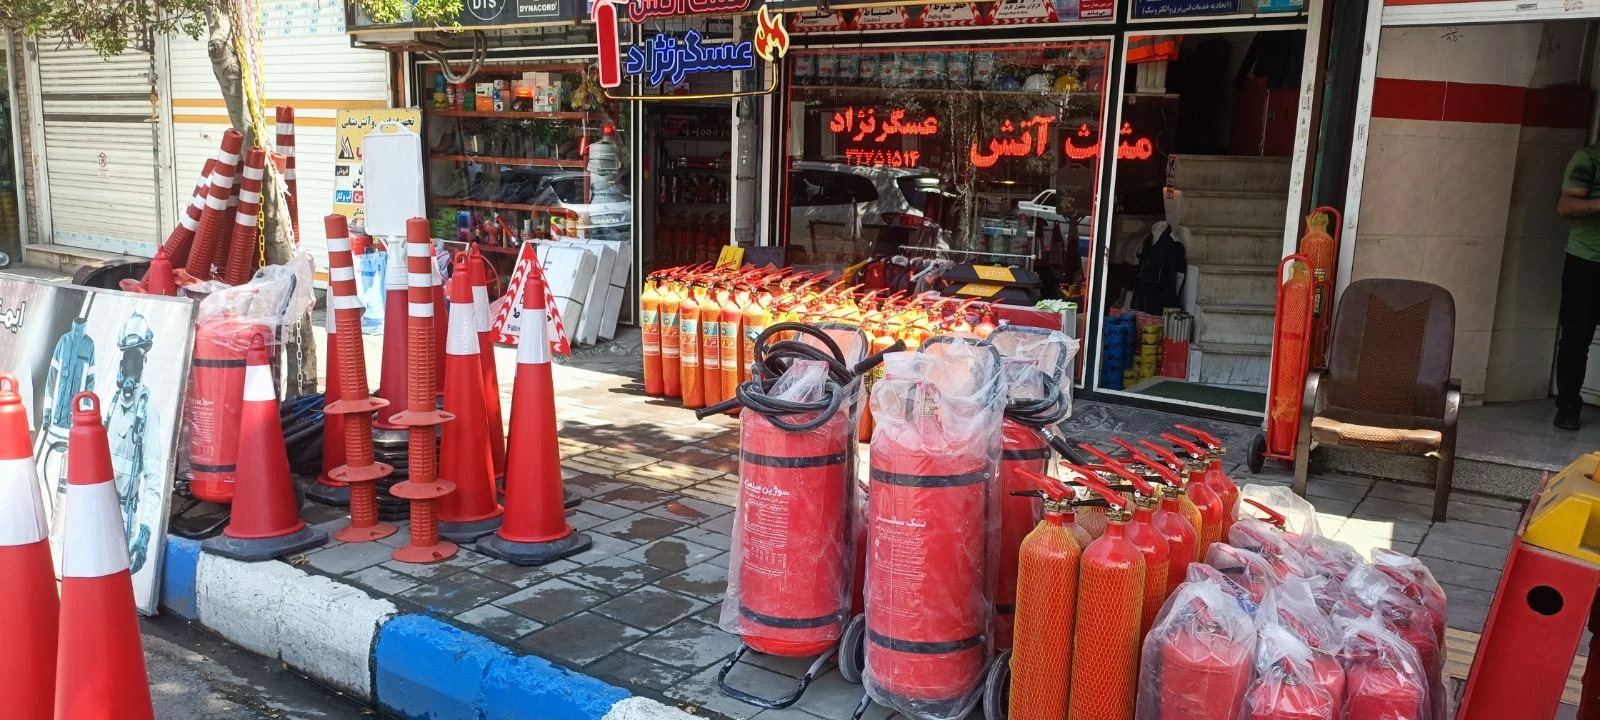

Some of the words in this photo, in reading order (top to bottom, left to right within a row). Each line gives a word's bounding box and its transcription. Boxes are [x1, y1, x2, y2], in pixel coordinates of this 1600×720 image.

[519, 3, 556, 13] DYNACORD
[864, 6, 897, 16] احتیاط
[969, 114, 1056, 168] آتش
[1065, 121, 1153, 160] مثث
